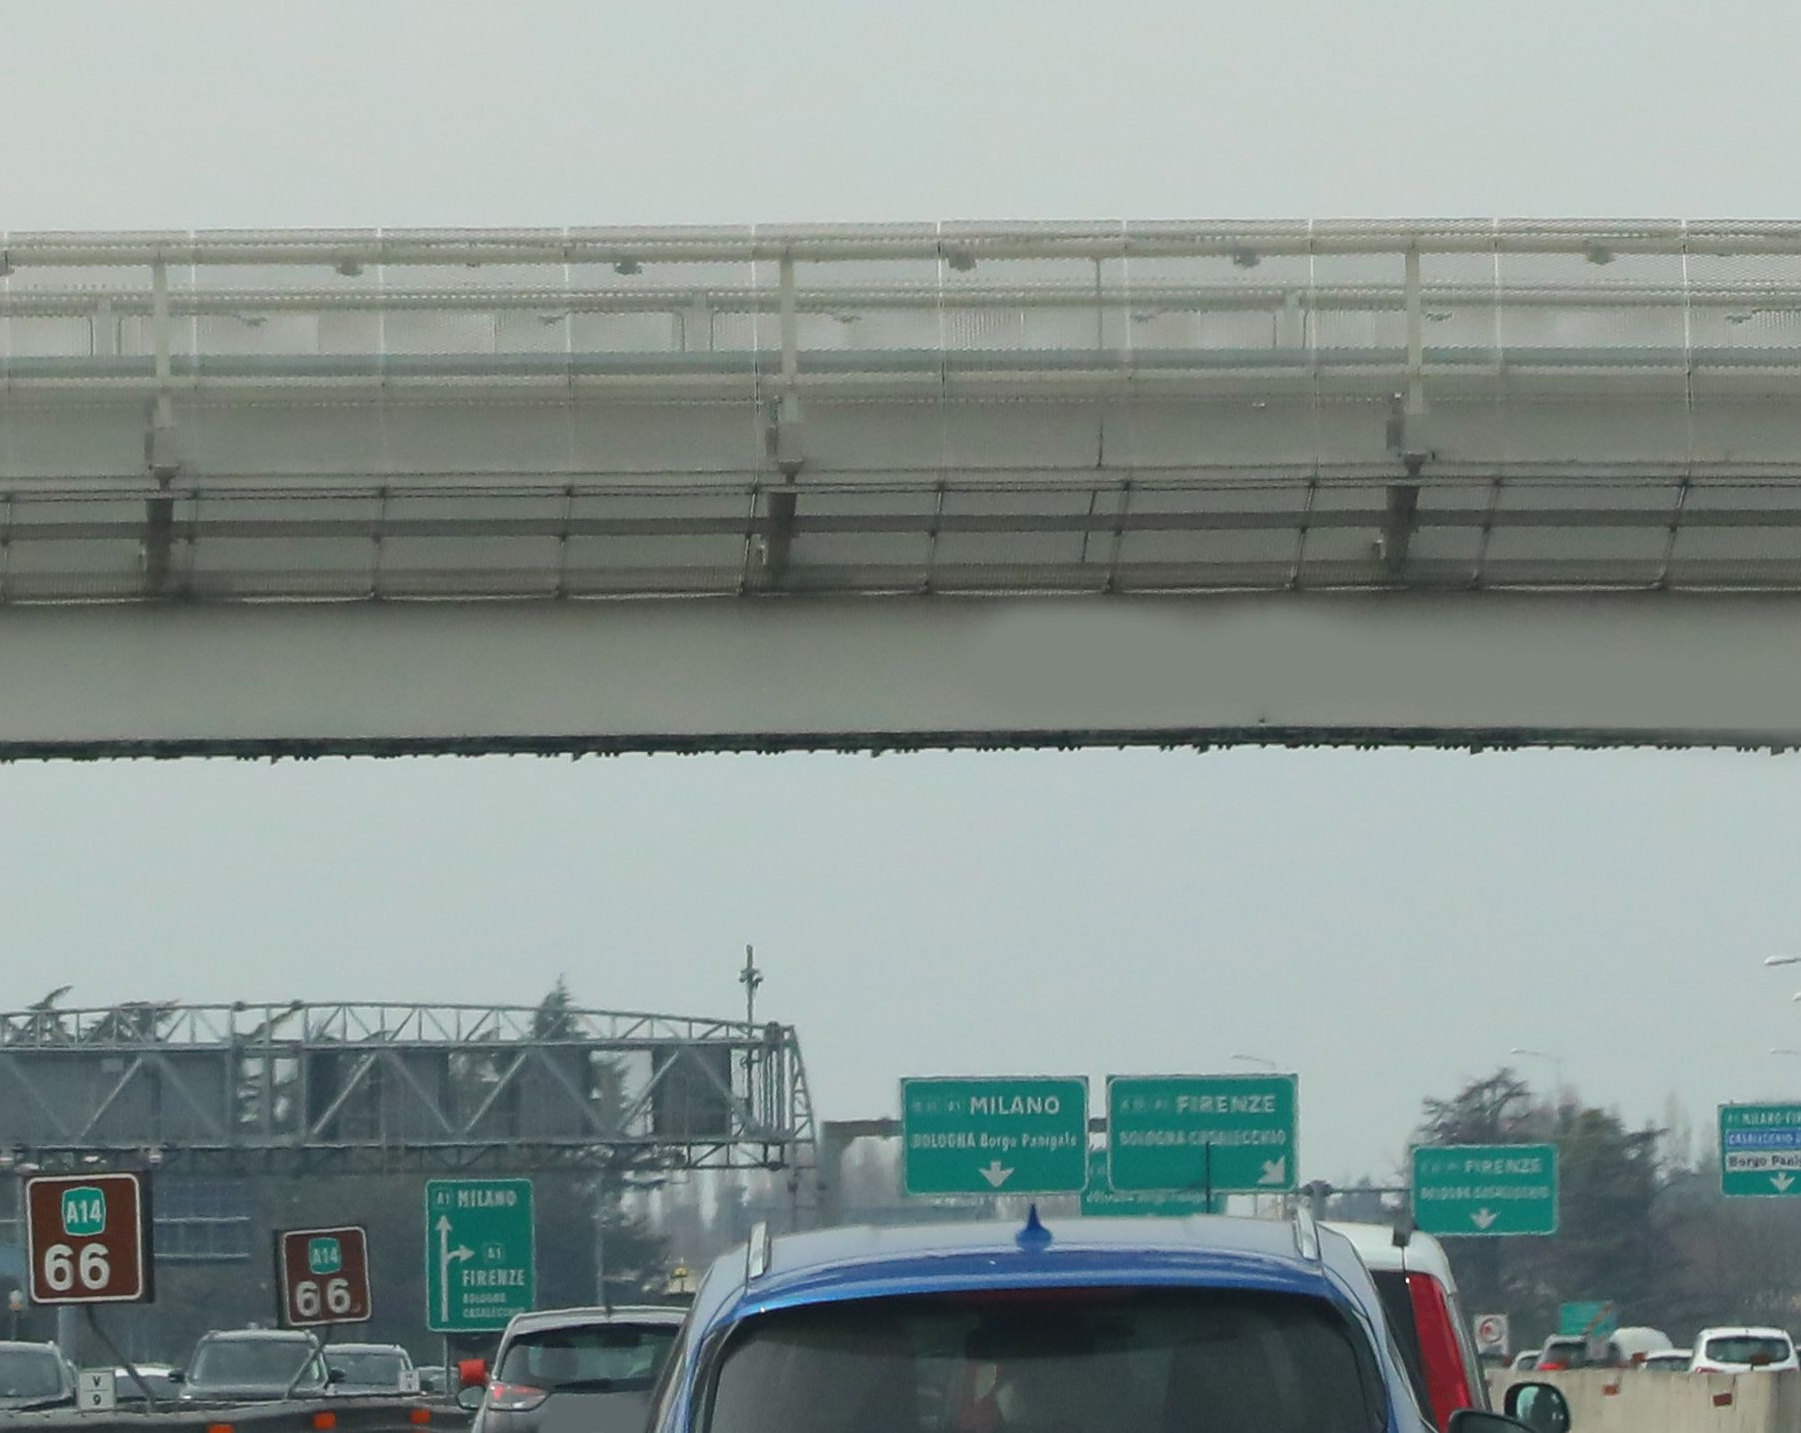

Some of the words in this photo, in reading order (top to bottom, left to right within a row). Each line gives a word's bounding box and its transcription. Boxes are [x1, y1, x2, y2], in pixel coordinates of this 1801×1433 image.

[969, 1095, 1061, 1116] MILANO
[1176, 1095, 1277, 1114] FIRENZE
[911, 1132, 976, 1149] BOLOGNA
[457, 1189, 518, 1208] MILANO
[65, 1199, 103, 1224] A14
[44, 1242, 111, 1292] 66
[462, 1269, 525, 1287] FIRENZE
[295, 1277, 352, 1317] 66
[92, 1375, 102, 1388] V
[92, 1394, 102, 1406] 9
